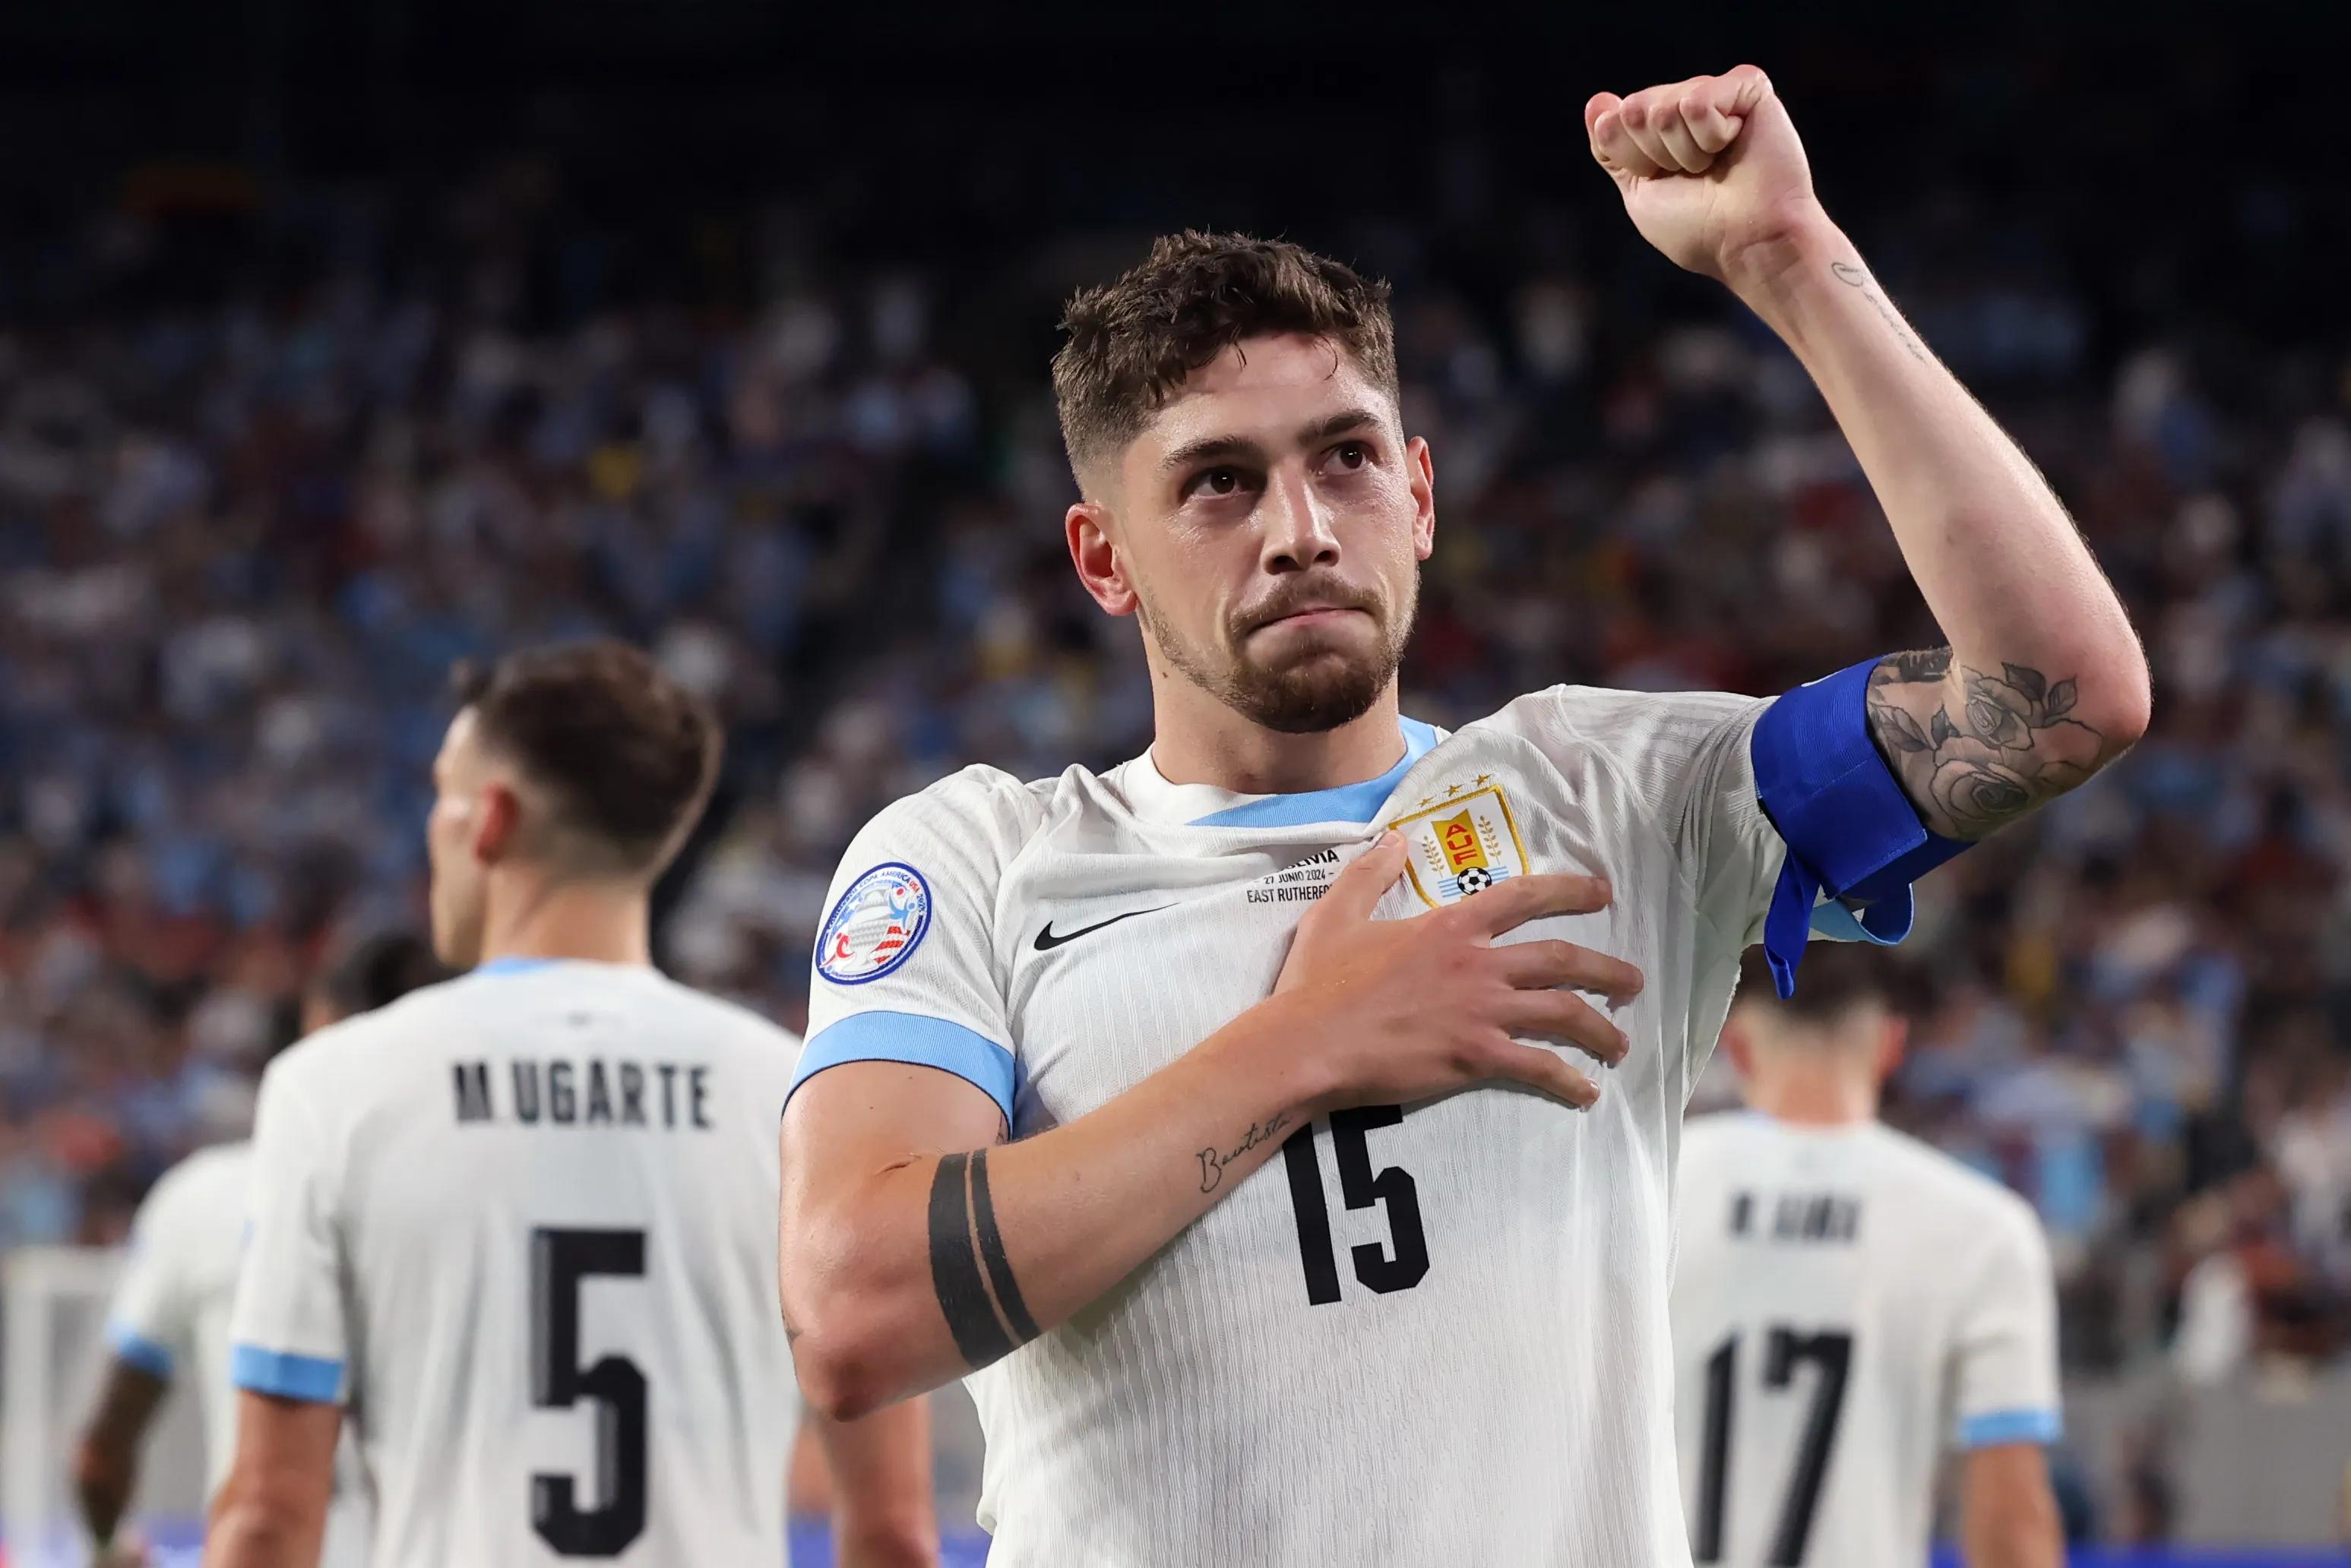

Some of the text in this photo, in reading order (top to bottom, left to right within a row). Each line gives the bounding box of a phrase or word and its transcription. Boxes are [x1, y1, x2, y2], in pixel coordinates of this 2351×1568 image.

[1287, 849, 1340, 868] IVIA
[1445, 824, 1478, 865] AUF
[1246, 884, 1333, 903] EAST RUTHERFO
[1264, 868, 1326, 884] 27 JUNIO 2024
[511, 1059, 714, 1130] UGARTE
[1282, 1105, 1430, 1306] 15
[530, 1227, 648, 1557] 5
[1696, 1326, 1854, 1568] 17
